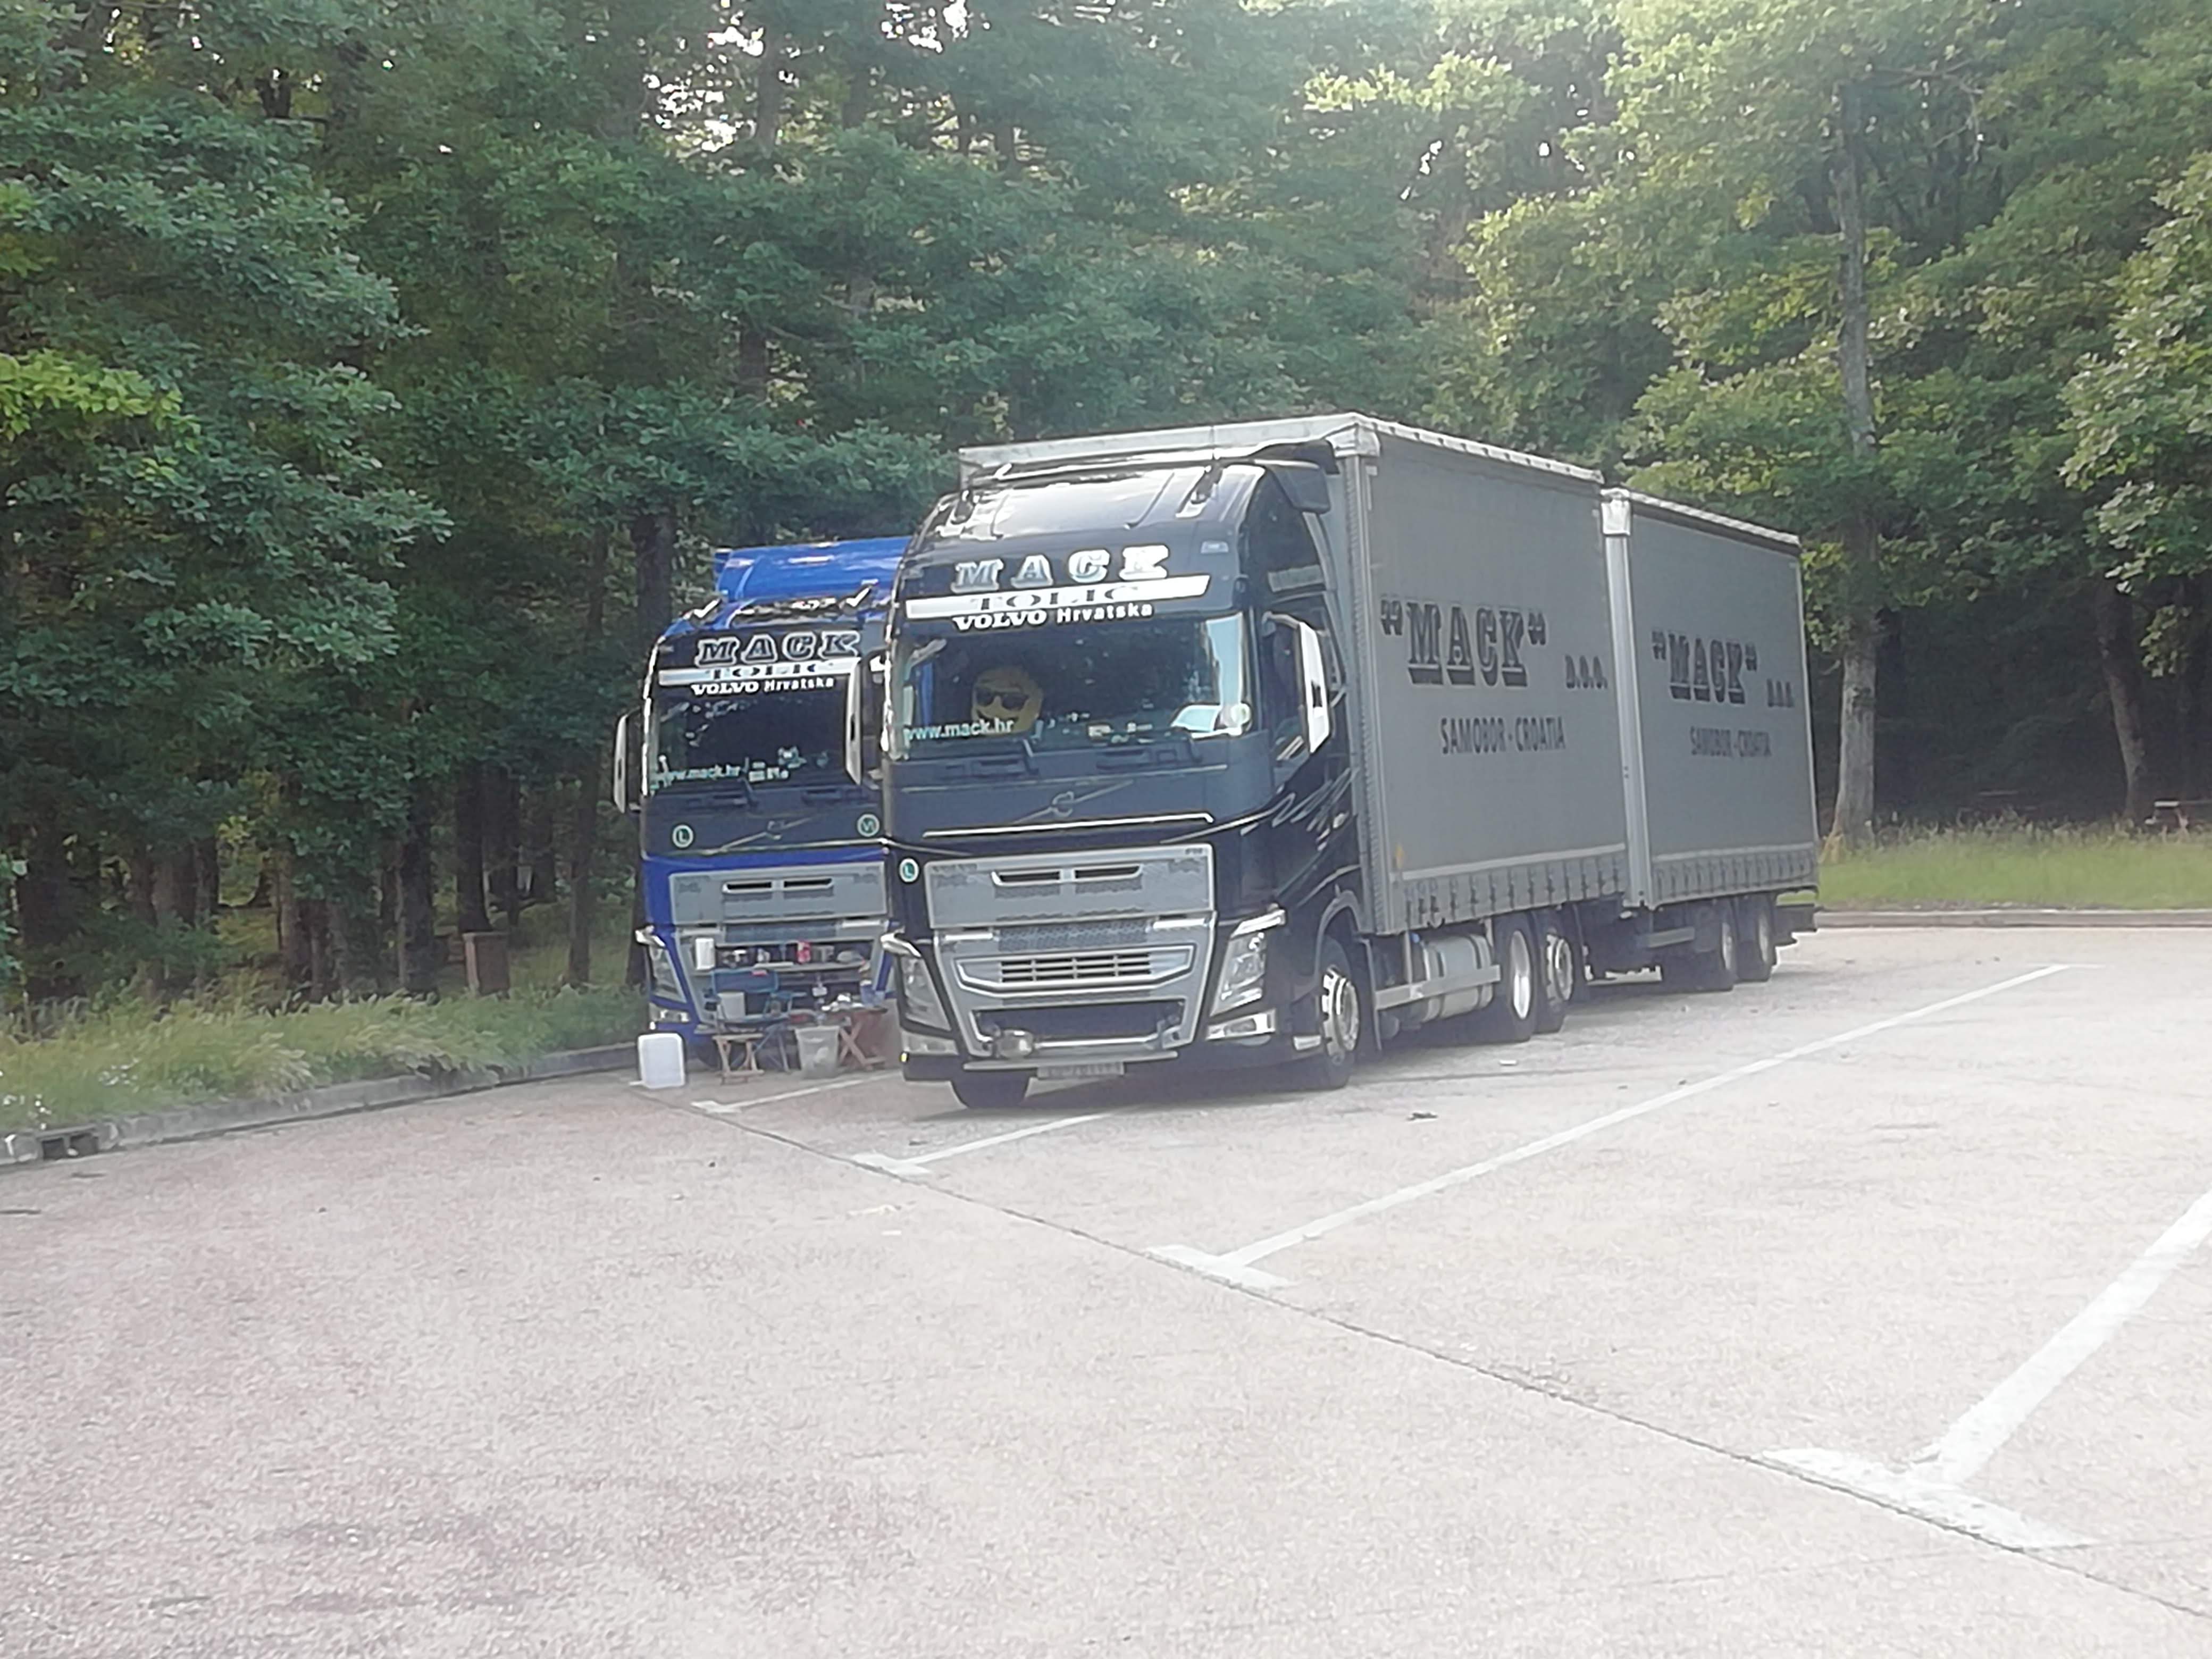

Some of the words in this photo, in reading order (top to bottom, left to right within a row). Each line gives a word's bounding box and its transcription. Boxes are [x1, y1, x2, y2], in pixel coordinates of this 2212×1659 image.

[951, 545, 1169, 593] MACK
[952, 610, 1046, 631] VOLVO
[1057, 604, 1152, 624] Hrvatska
[694, 631, 860, 666] MACK
[691, 682, 759, 696] VOLVO
